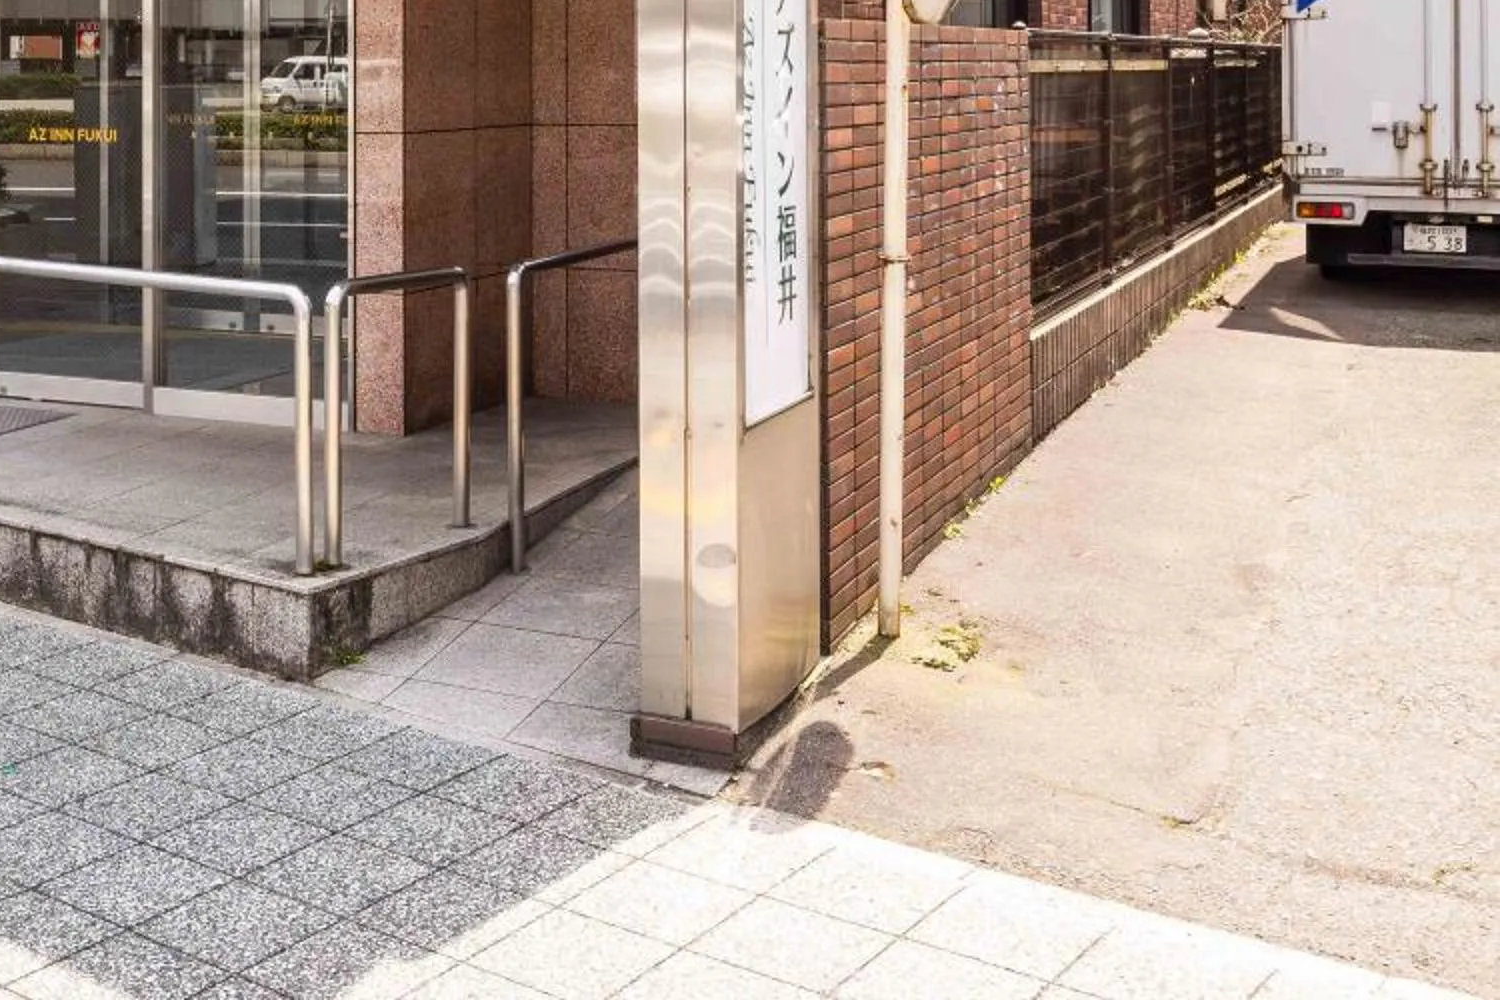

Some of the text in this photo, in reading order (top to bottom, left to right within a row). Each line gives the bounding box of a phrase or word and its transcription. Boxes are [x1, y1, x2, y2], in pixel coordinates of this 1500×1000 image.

[29, 127, 118, 143] AZ INN FUKUI
